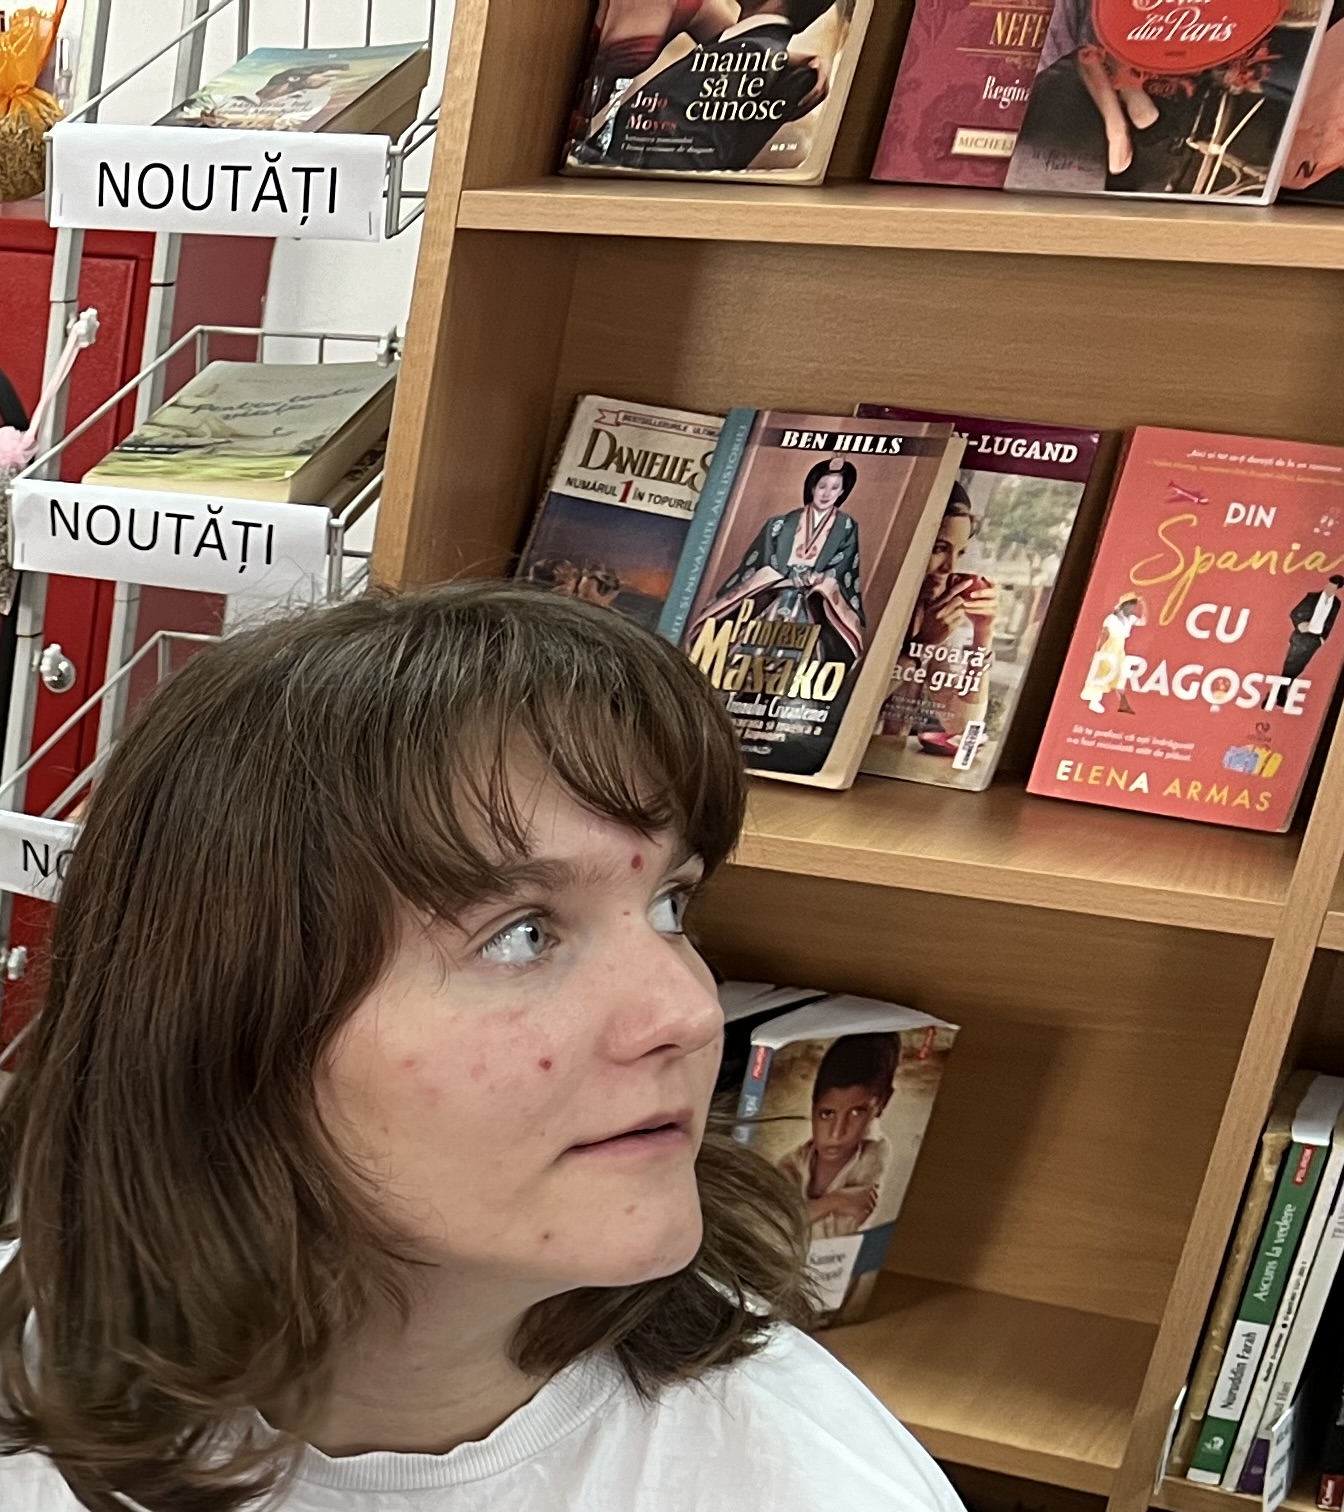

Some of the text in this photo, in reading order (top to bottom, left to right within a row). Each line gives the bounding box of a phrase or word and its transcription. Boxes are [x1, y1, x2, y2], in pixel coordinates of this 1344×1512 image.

[990, 11, 1047, 47] NEFE
[1127, 8, 1238, 43] din Paris
[690, 43, 788, 72] înainte
[631, 90, 669, 113] Jojo
[699, 73, 765, 98] să te
[685, 99, 786, 122] cunosc
[98, 151, 339, 226] NOUTĂȚI
[577, 428, 696, 488] DANIELLE
[780, 429, 904, 455] BEN HILLS
[619, 480, 635, 504] 1
[1224, 502, 1277, 529] DIN
[50, 499, 274, 573] NOUTĂȚI
[1129, 513, 1344, 626] Spania
[1185, 602, 1250, 643] CU
[892, 661, 982, 696] ace griji
[1085, 650, 1312, 716] DRAGOSTE
[1056, 760, 1273, 812] ELENA ARMAS
[1277, 1203, 1297, 1245] vedere
[1273, 1245, 1285, 1259] la
[1253, 1261, 1280, 1302] Ascuns
[1220, 1331, 1258, 1410] Nuruddin Farah
